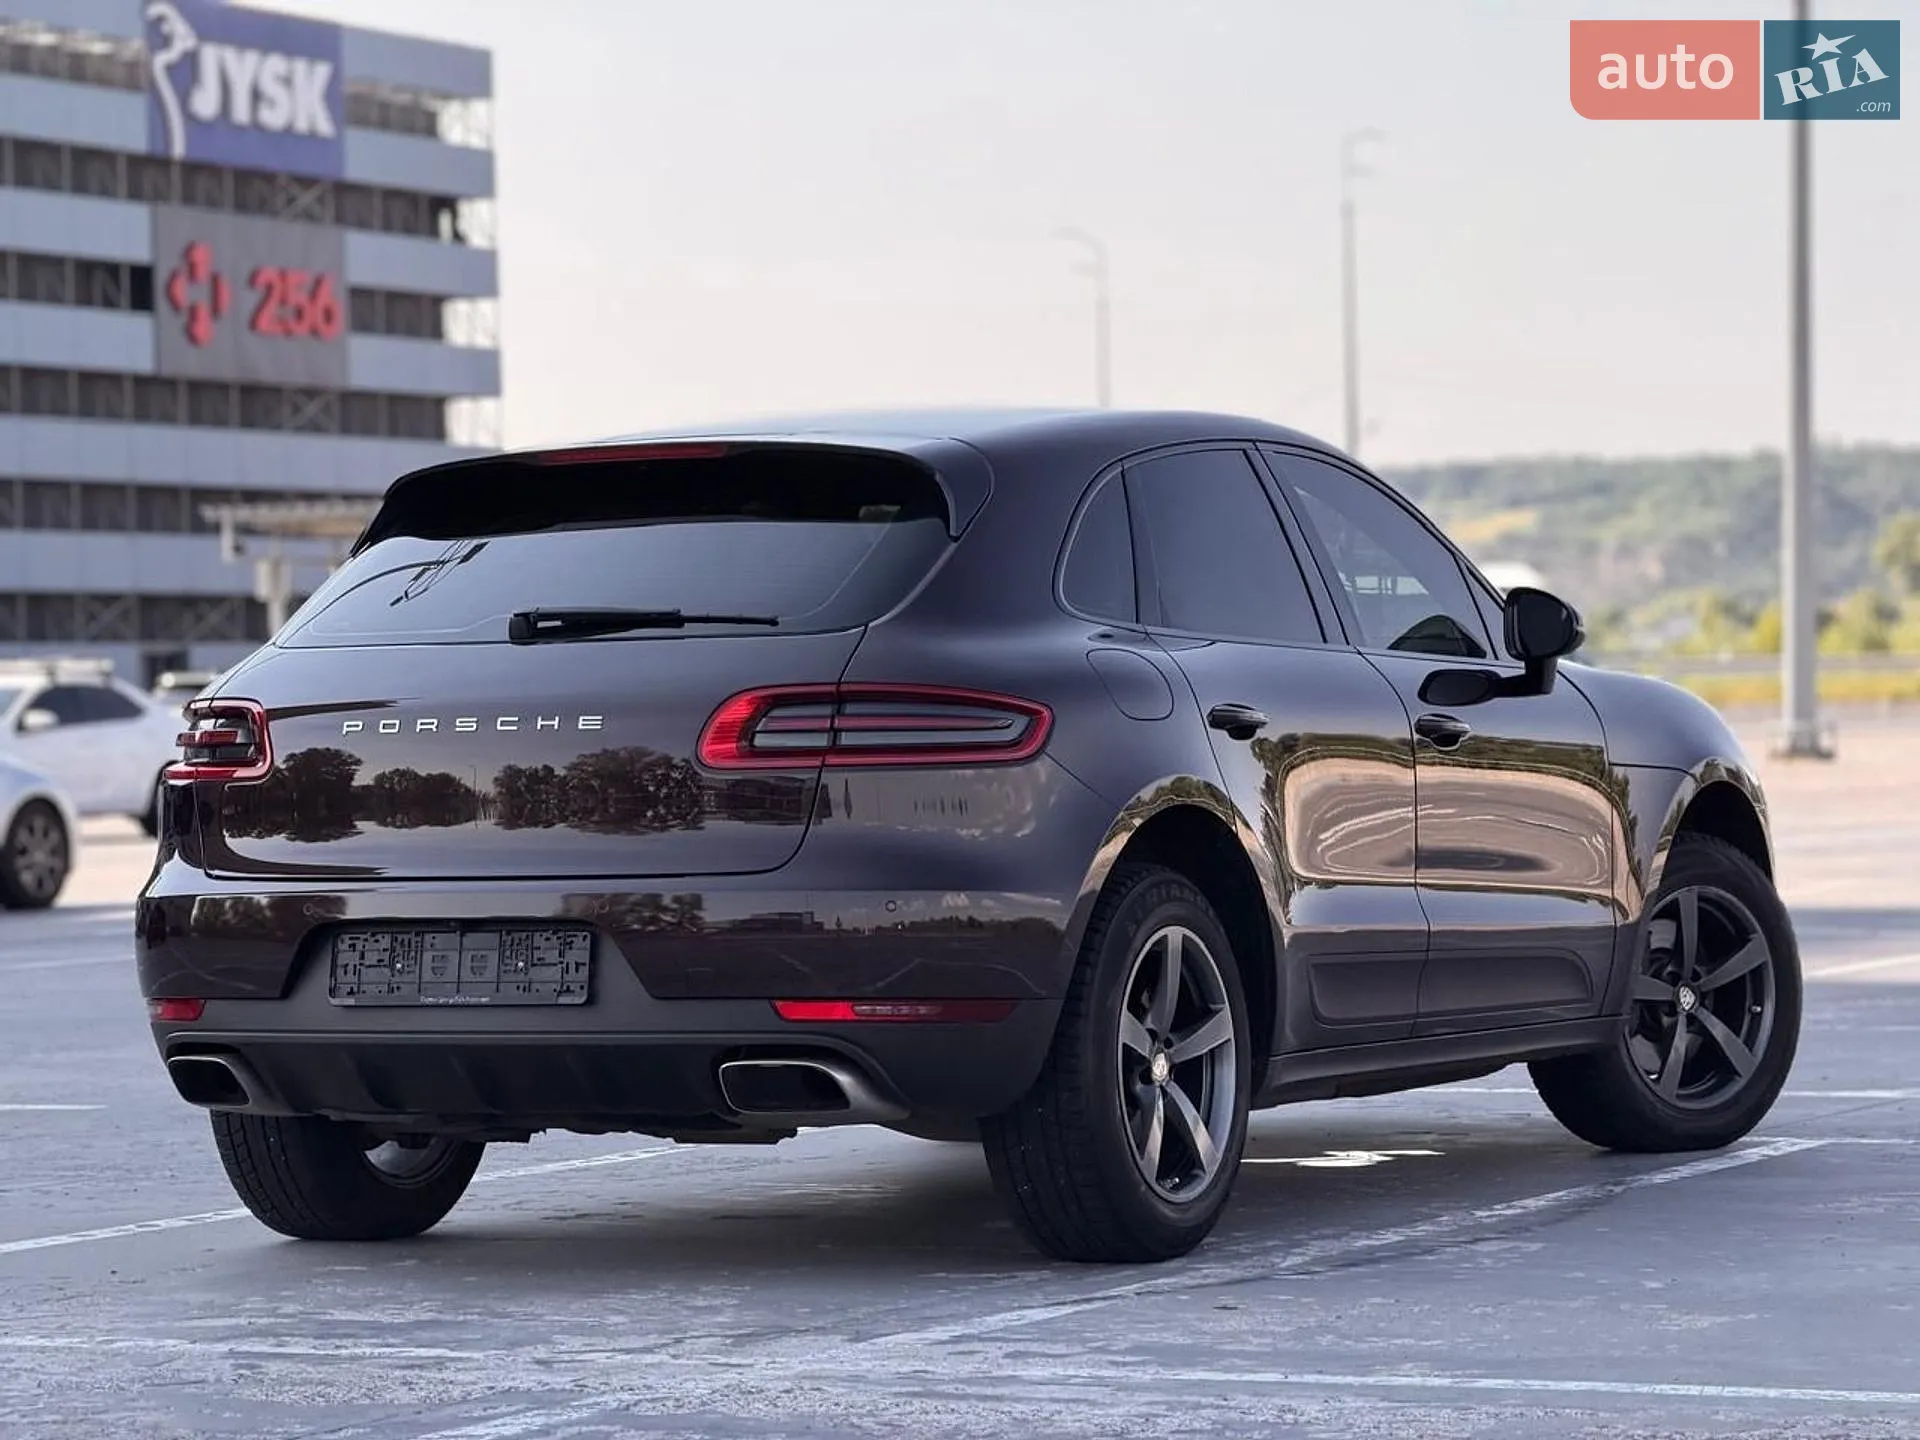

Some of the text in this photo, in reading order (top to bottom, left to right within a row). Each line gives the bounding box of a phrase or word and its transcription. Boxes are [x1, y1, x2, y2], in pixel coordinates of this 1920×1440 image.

[189, 42, 337, 139] JYSK
[250, 266, 341, 340] 256
[342, 715, 604, 735] PORSCHE
